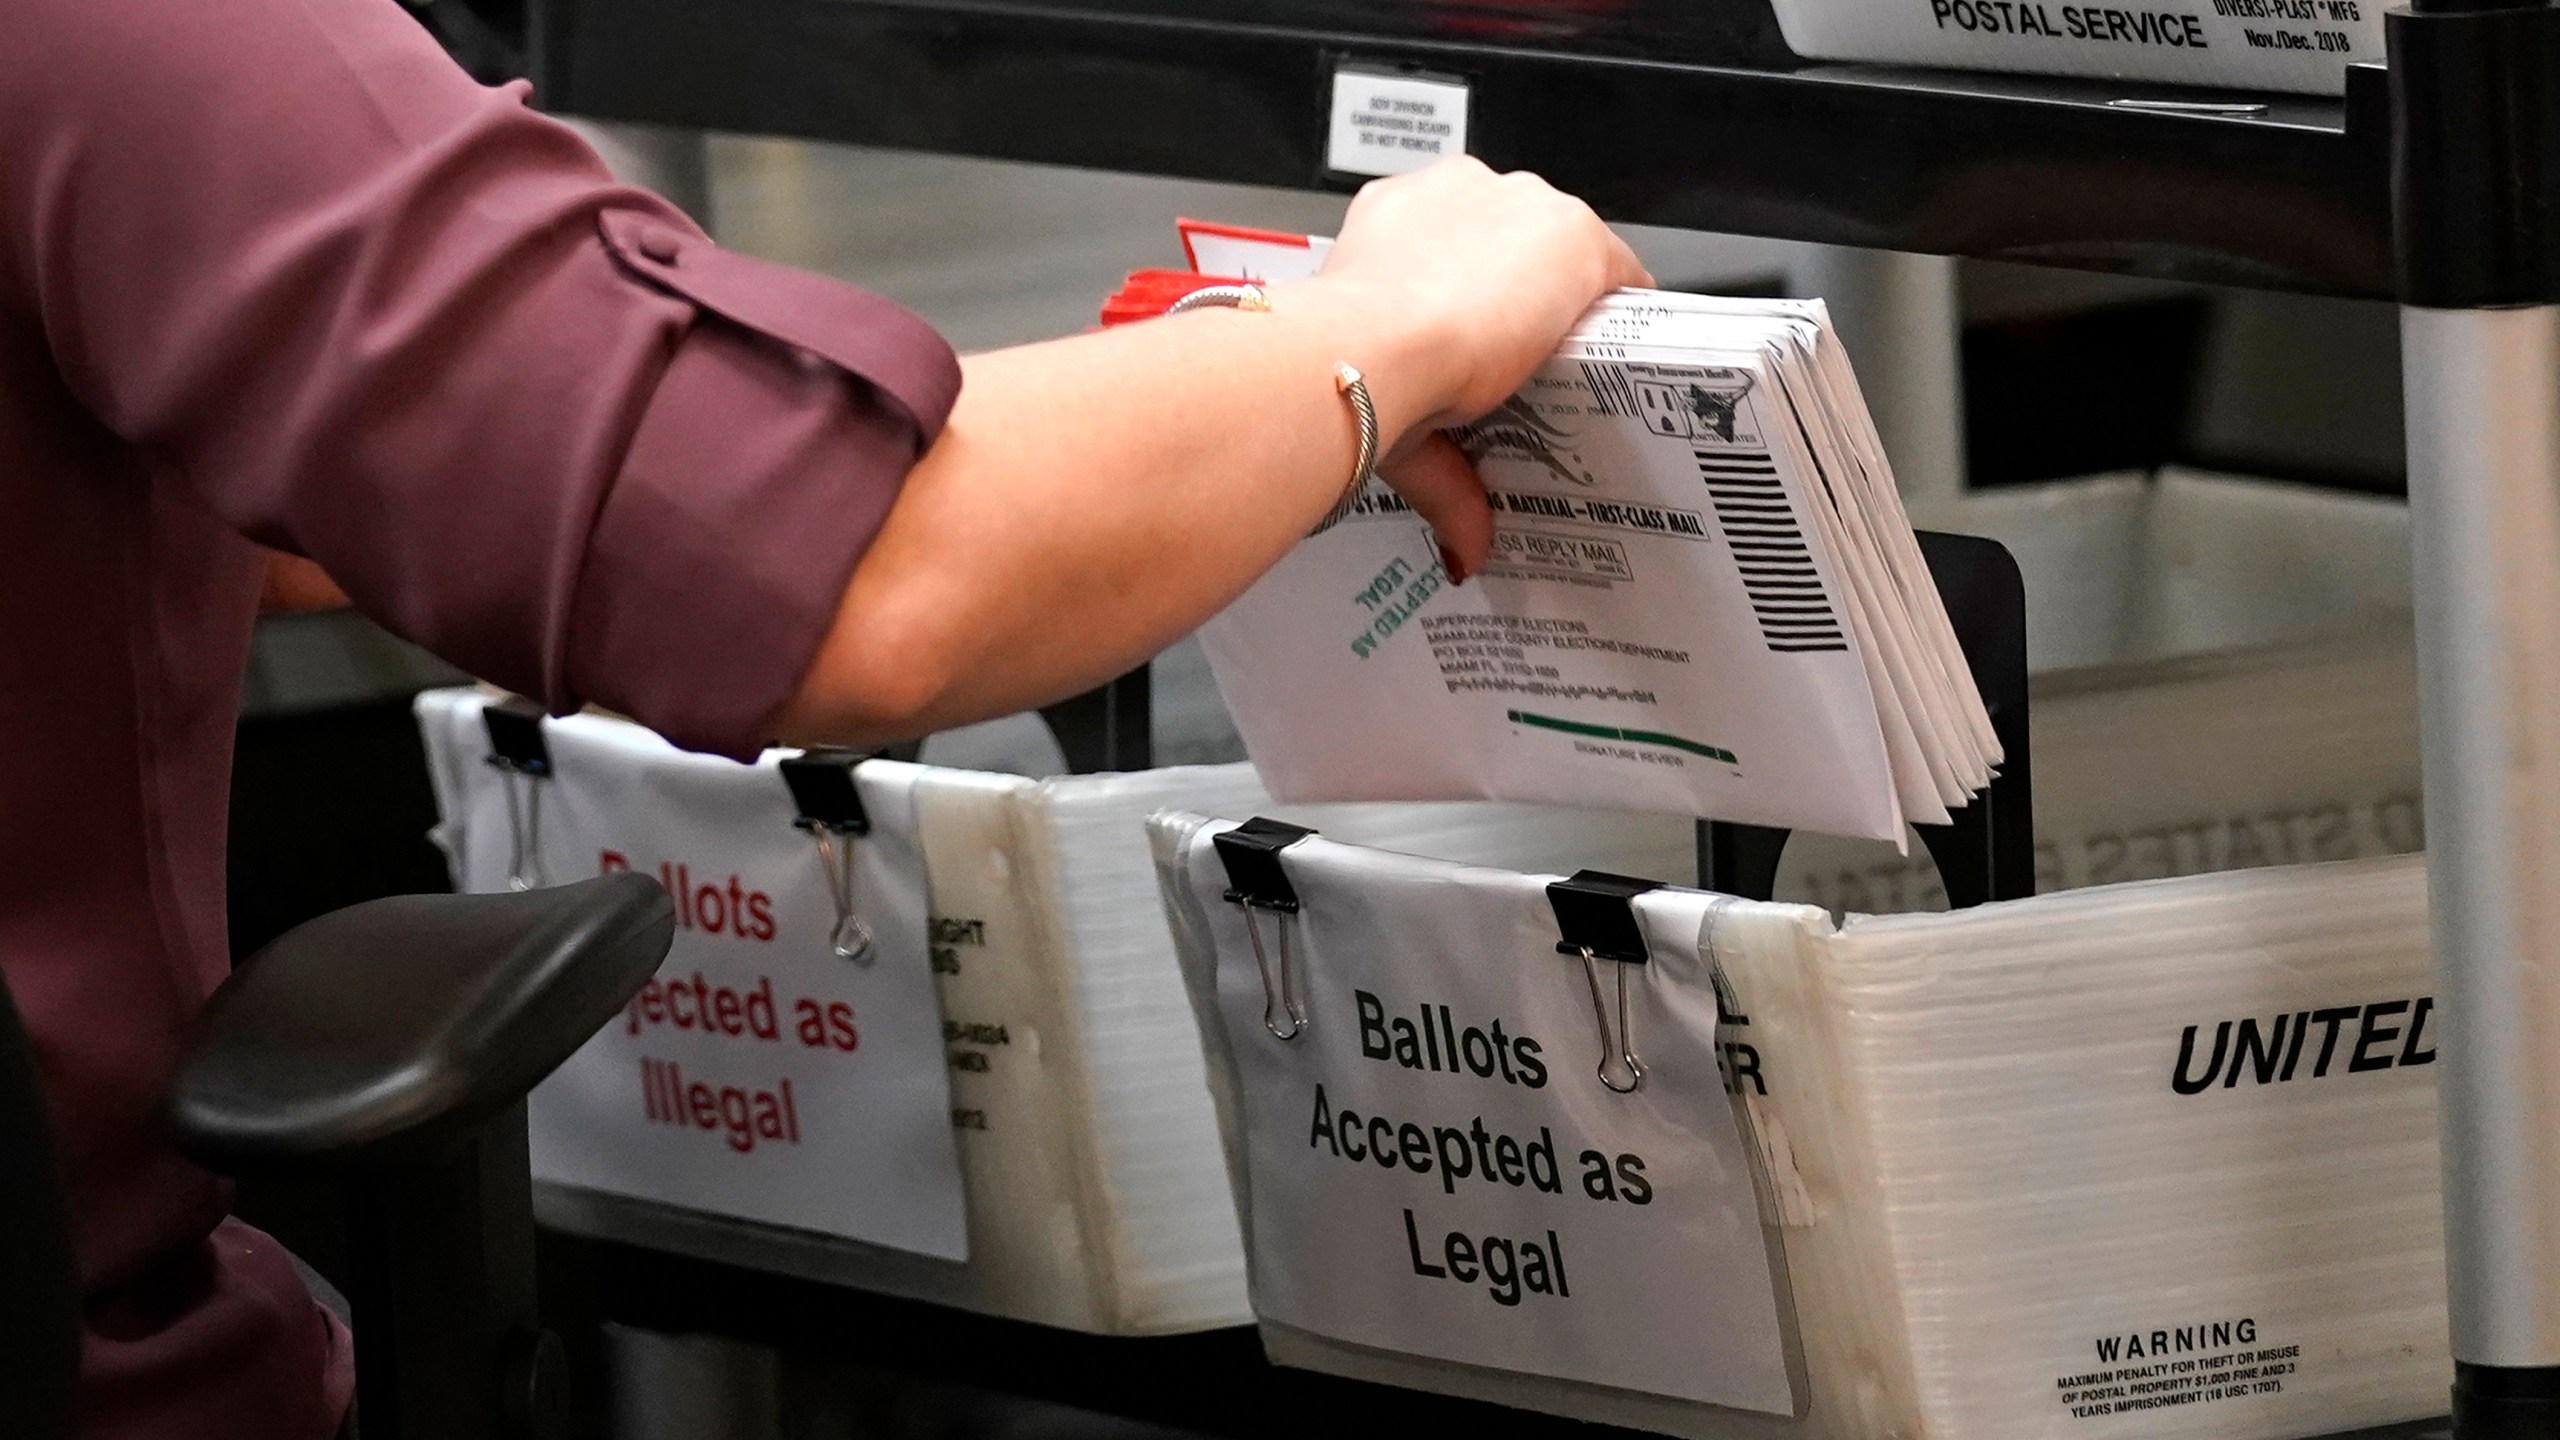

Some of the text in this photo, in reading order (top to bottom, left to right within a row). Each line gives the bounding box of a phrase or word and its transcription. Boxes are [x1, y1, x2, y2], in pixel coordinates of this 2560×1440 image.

[1931, 0, 2207, 48] POSTAL SERVICE
[2327, 1, 2360, 21] MFG
[2244, 28, 2350, 52] Nov./Dec. 2018
[1667, 512, 1704, 536] MAIL
[1526, 534, 1577, 558] REPLY
[1581, 541, 1623, 564] MAIL
[601, 850, 777, 941] llots
[626, 970, 860, 1052] ected as
[1355, 989, 1549, 1089] Ballots
[640, 1055, 798, 1154] Illegal
[1310, 1083, 1653, 1206] Accepted as
[1403, 1208, 1570, 1307] Legal
[2096, 1318, 2258, 1363] WARNING
[2057, 1345, 2301, 1389] MAXIMUM PENALTY FOR THEFT OR MISUSE
[2062, 1392, 2080, 1404] OF
[2081, 1386, 2126, 1402] POSTAL
[2130, 1378, 2192, 1396] PROPERTY
[2233, 1368, 2259, 1381] FINE
[2261, 1364, 2286, 1378] AND
[2288, 1363, 2296, 1374] 3
[2071, 1403, 2112, 1419] YEARS
[2114, 1391, 2203, 1413] IMPRISONMENT
[2205, 1389, 2222, 1404] (18
[2225, 1384, 2249, 1398] USC
